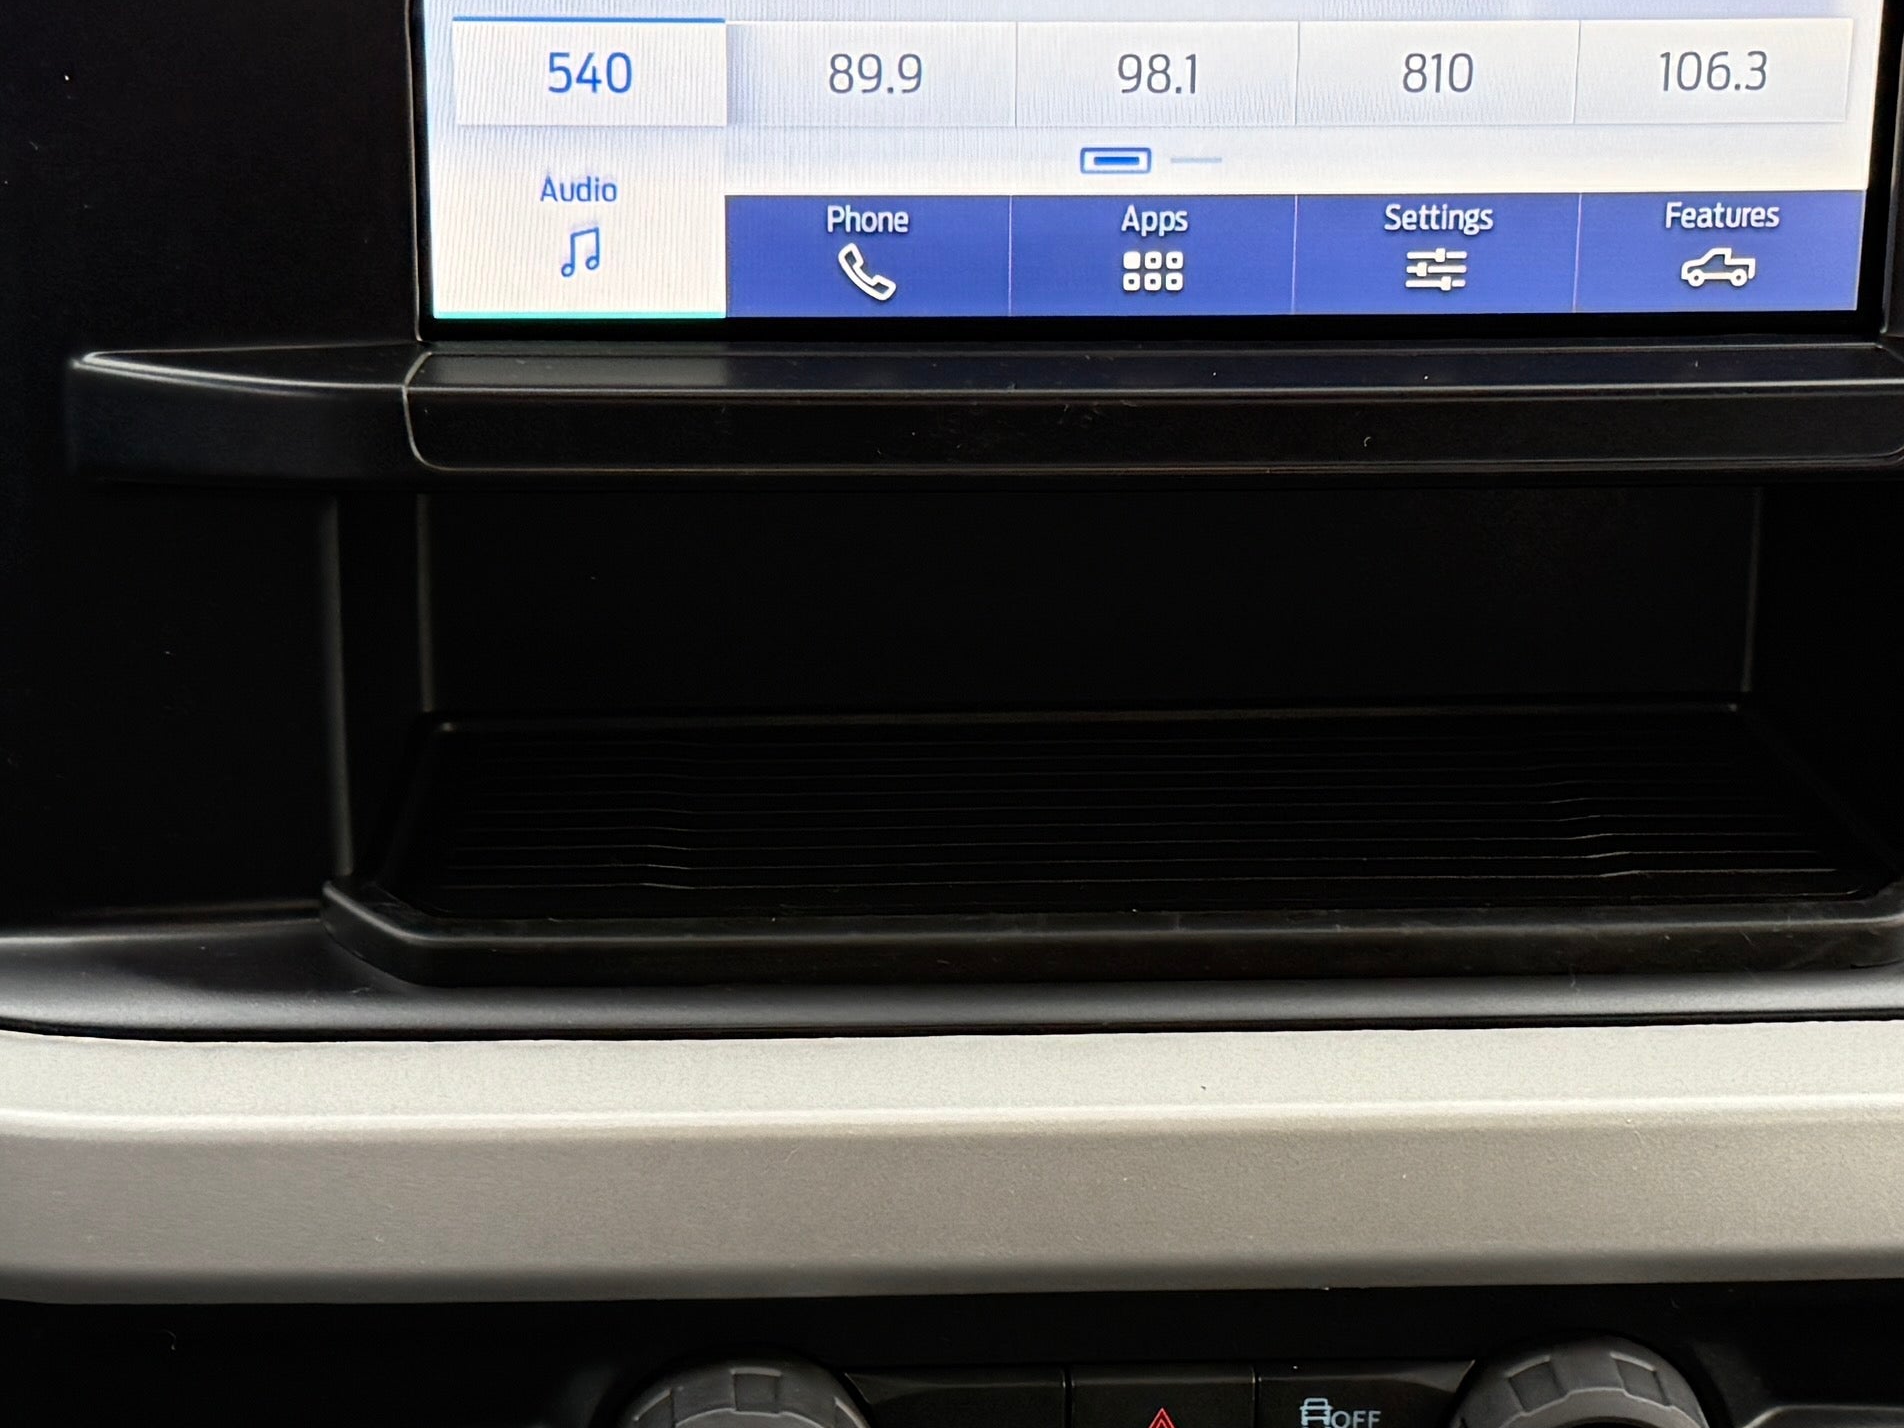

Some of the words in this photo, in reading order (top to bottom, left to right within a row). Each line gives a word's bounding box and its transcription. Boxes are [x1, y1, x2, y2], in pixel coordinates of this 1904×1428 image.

[549, 52, 632, 93] 540
[829, 54, 922, 94] 89.9
[1118, 54, 1196, 94] 98.1
[1403, 53, 1473, 93] 810
[1660, 51, 1767, 91] 106.3
[540, 175, 617, 202] Audio
[828, 205, 908, 232] Phone
[1122, 204, 1188, 236] Apps
[1385, 204, 1493, 235] Settings
[1666, 202, 1779, 228] Features
